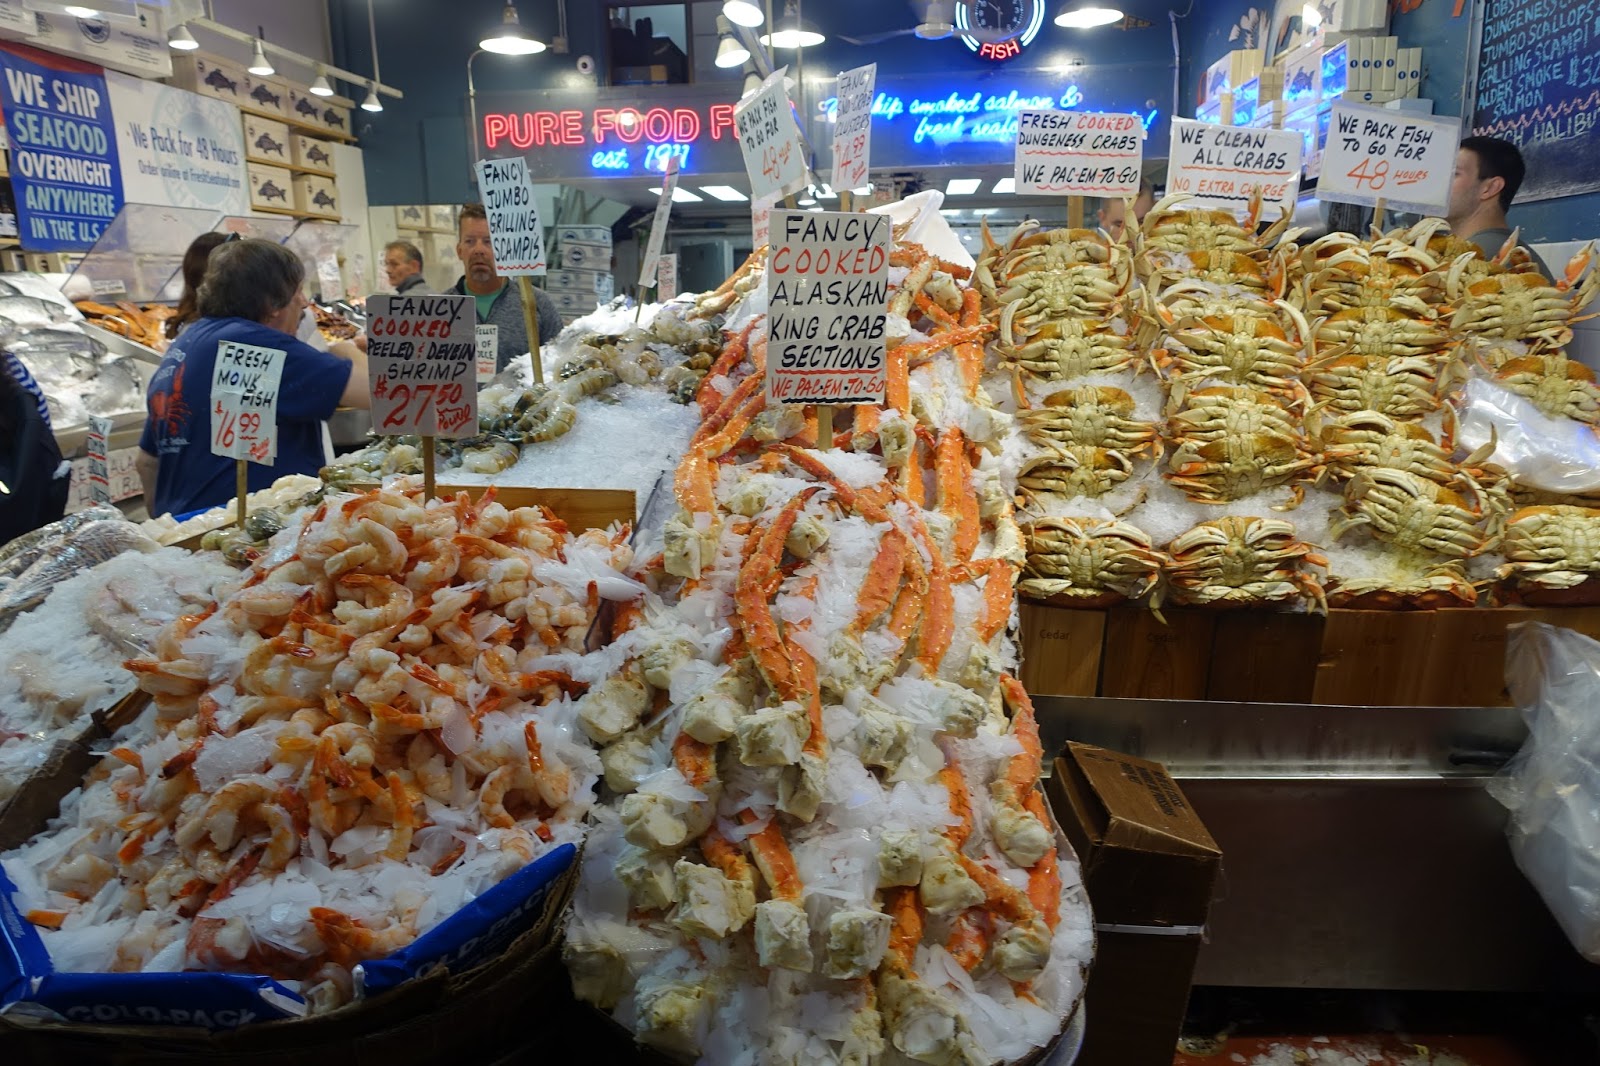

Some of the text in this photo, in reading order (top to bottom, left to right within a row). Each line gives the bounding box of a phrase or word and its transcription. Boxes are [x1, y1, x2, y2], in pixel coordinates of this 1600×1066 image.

[1483, 31, 1526, 68] JUMBO
[1527, 1, 1594, 46] SCALLOPS
[980, 40, 1020, 59] FISH
[5, 67, 100, 119] WE SHIP
[841, 69, 873, 95] FANCY
[1477, 79, 1512, 111] ALDER
[1516, 61, 1565, 96] SMOKE
[763, 94, 778, 117] FISH
[871, 85, 1079, 120] hip smoked salmon &
[1492, 89, 1544, 123] SALMON
[13, 111, 107, 155] SEAFOOD
[485, 111, 584, 148] PURE
[594, 108, 699, 143] FOOD
[913, 115, 1018, 143] fresh seafo
[1021, 113, 1071, 130] FRESH
[1338, 112, 1433, 145] WE PACK FISH
[129, 121, 238, 165] We Pack for 48 Hours
[746, 136, 755, 152] TO
[1019, 132, 1137, 150] DUNGENESS CRABS
[1180, 126, 1268, 149] WE CLEAN
[1342, 138, 1426, 161] TO GO FOR
[17, 151, 112, 187] OVERNIGHT
[591, 147, 629, 170] est.
[763, 145, 780, 183] 48
[1193, 148, 1288, 170] ALL CRABS
[484, 159, 523, 185] FANCY
[1023, 163, 1045, 184] WE
[1347, 158, 1428, 190] 48 HOURS
[486, 186, 529, 209] JUMBO
[1172, 176, 1289, 196] NO EXTRA CHRGE
[25, 184, 115, 217] ANYWHERE
[30, 216, 49, 239] IN
[49, 219, 76, 241] THE
[490, 210, 536, 234] GRILLING
[785, 215, 883, 251] FANCY
[770, 277, 888, 307] ALASKAN
[389, 296, 466, 326] FANCY
[770, 315, 887, 342] KING CRAB
[223, 346, 274, 371] FRESH
[367, 338, 415, 360] PEELED
[781, 345, 882, 369] SECTIONS
[217, 369, 261, 390] MONK
[388, 363, 467, 381] SHRIMP
[240, 388, 275, 408] FISH
[771, 377, 791, 398] WE
[1039, 629, 1070, 640] Cedar
